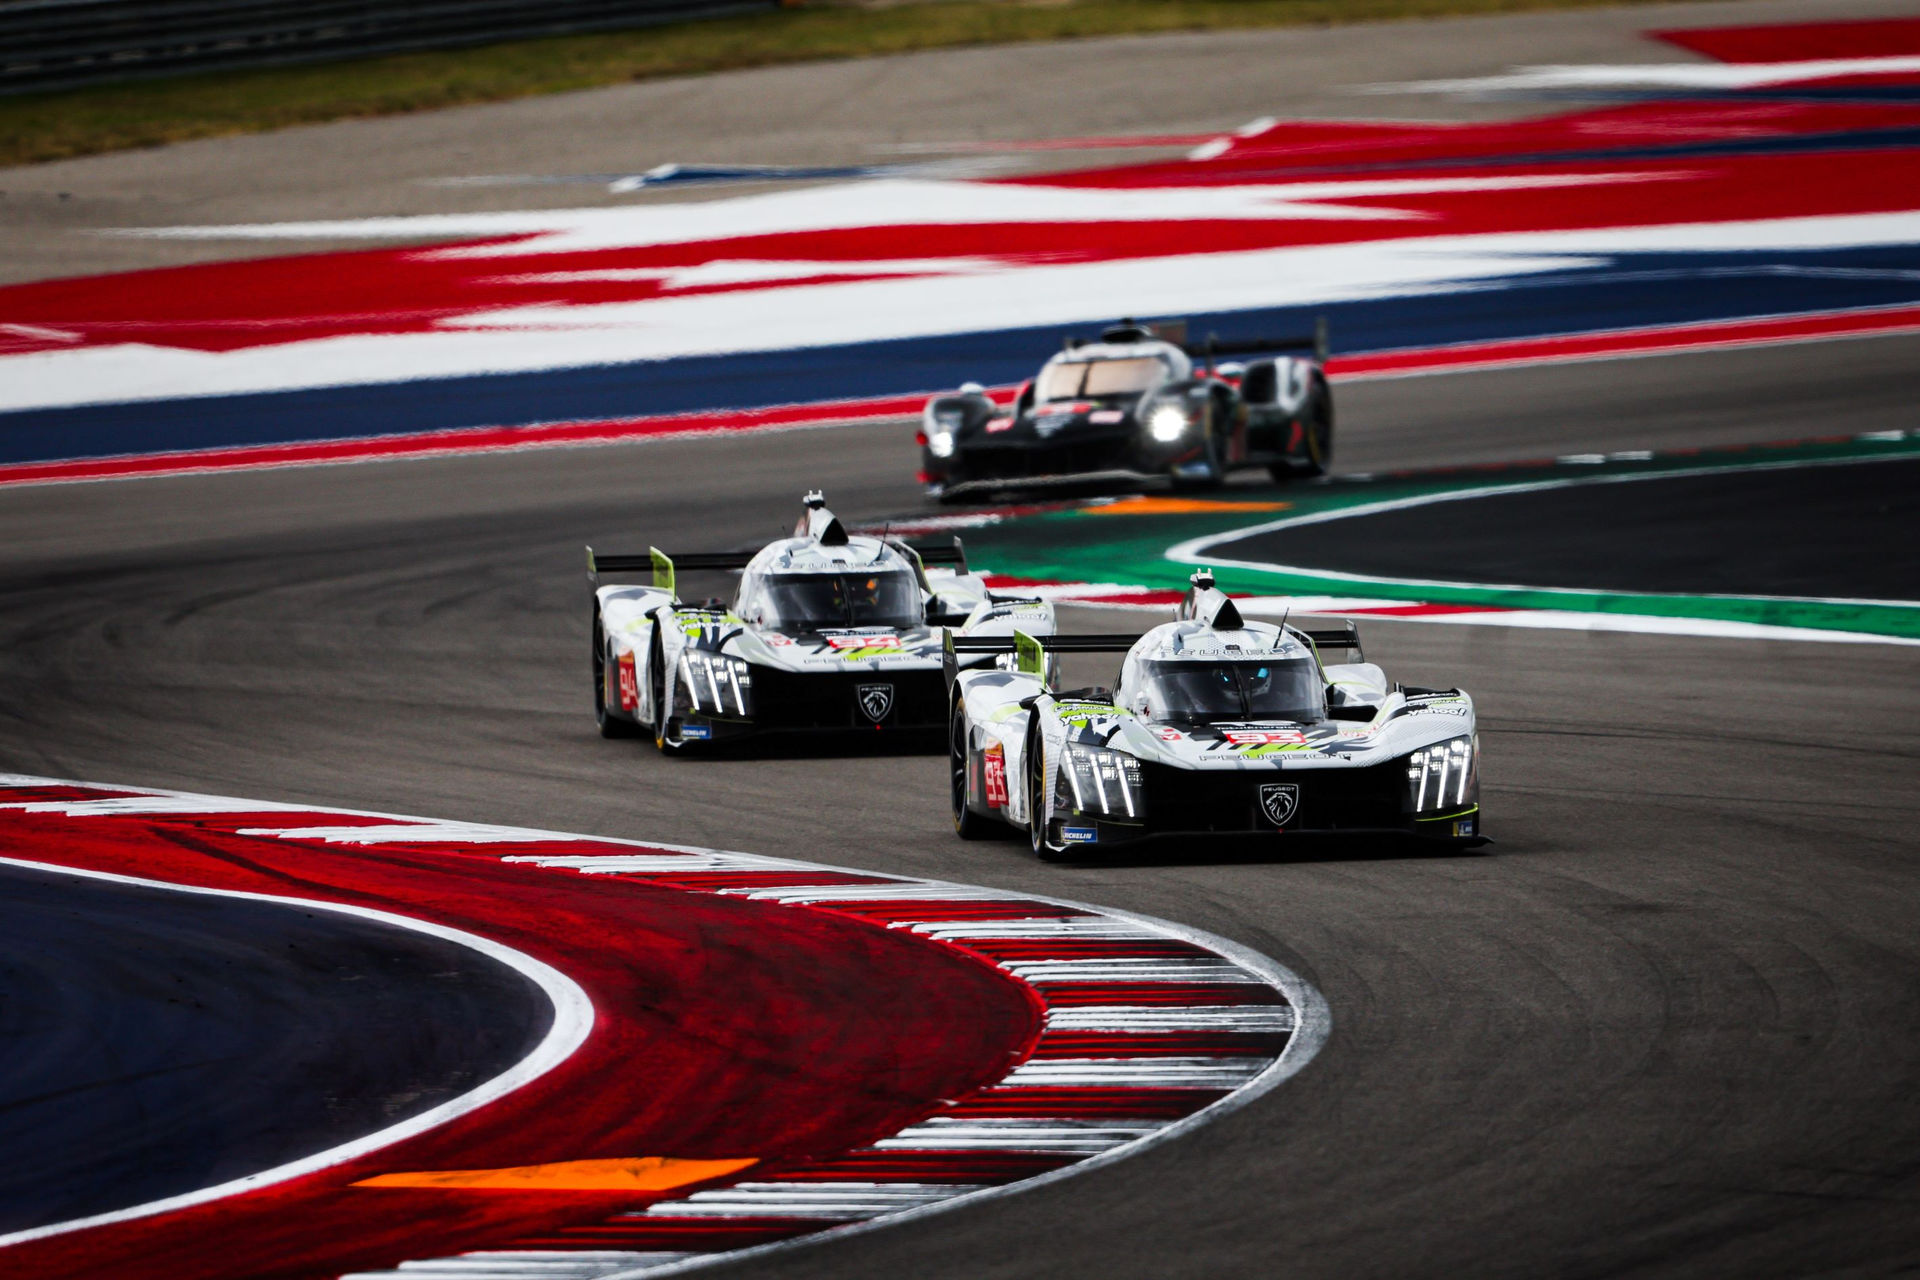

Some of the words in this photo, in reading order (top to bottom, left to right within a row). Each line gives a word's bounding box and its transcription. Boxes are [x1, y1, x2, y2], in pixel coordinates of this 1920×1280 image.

[834, 636, 901, 648] 94
[620, 666, 639, 705] 94
[1407, 707, 1468, 717] yahoo!
[1060, 712, 1121, 727] yahoo!
[1230, 732, 1303, 744] 93
[1198, 752, 1352, 762] PEUGEOT
[984, 760, 1008, 802] 93
